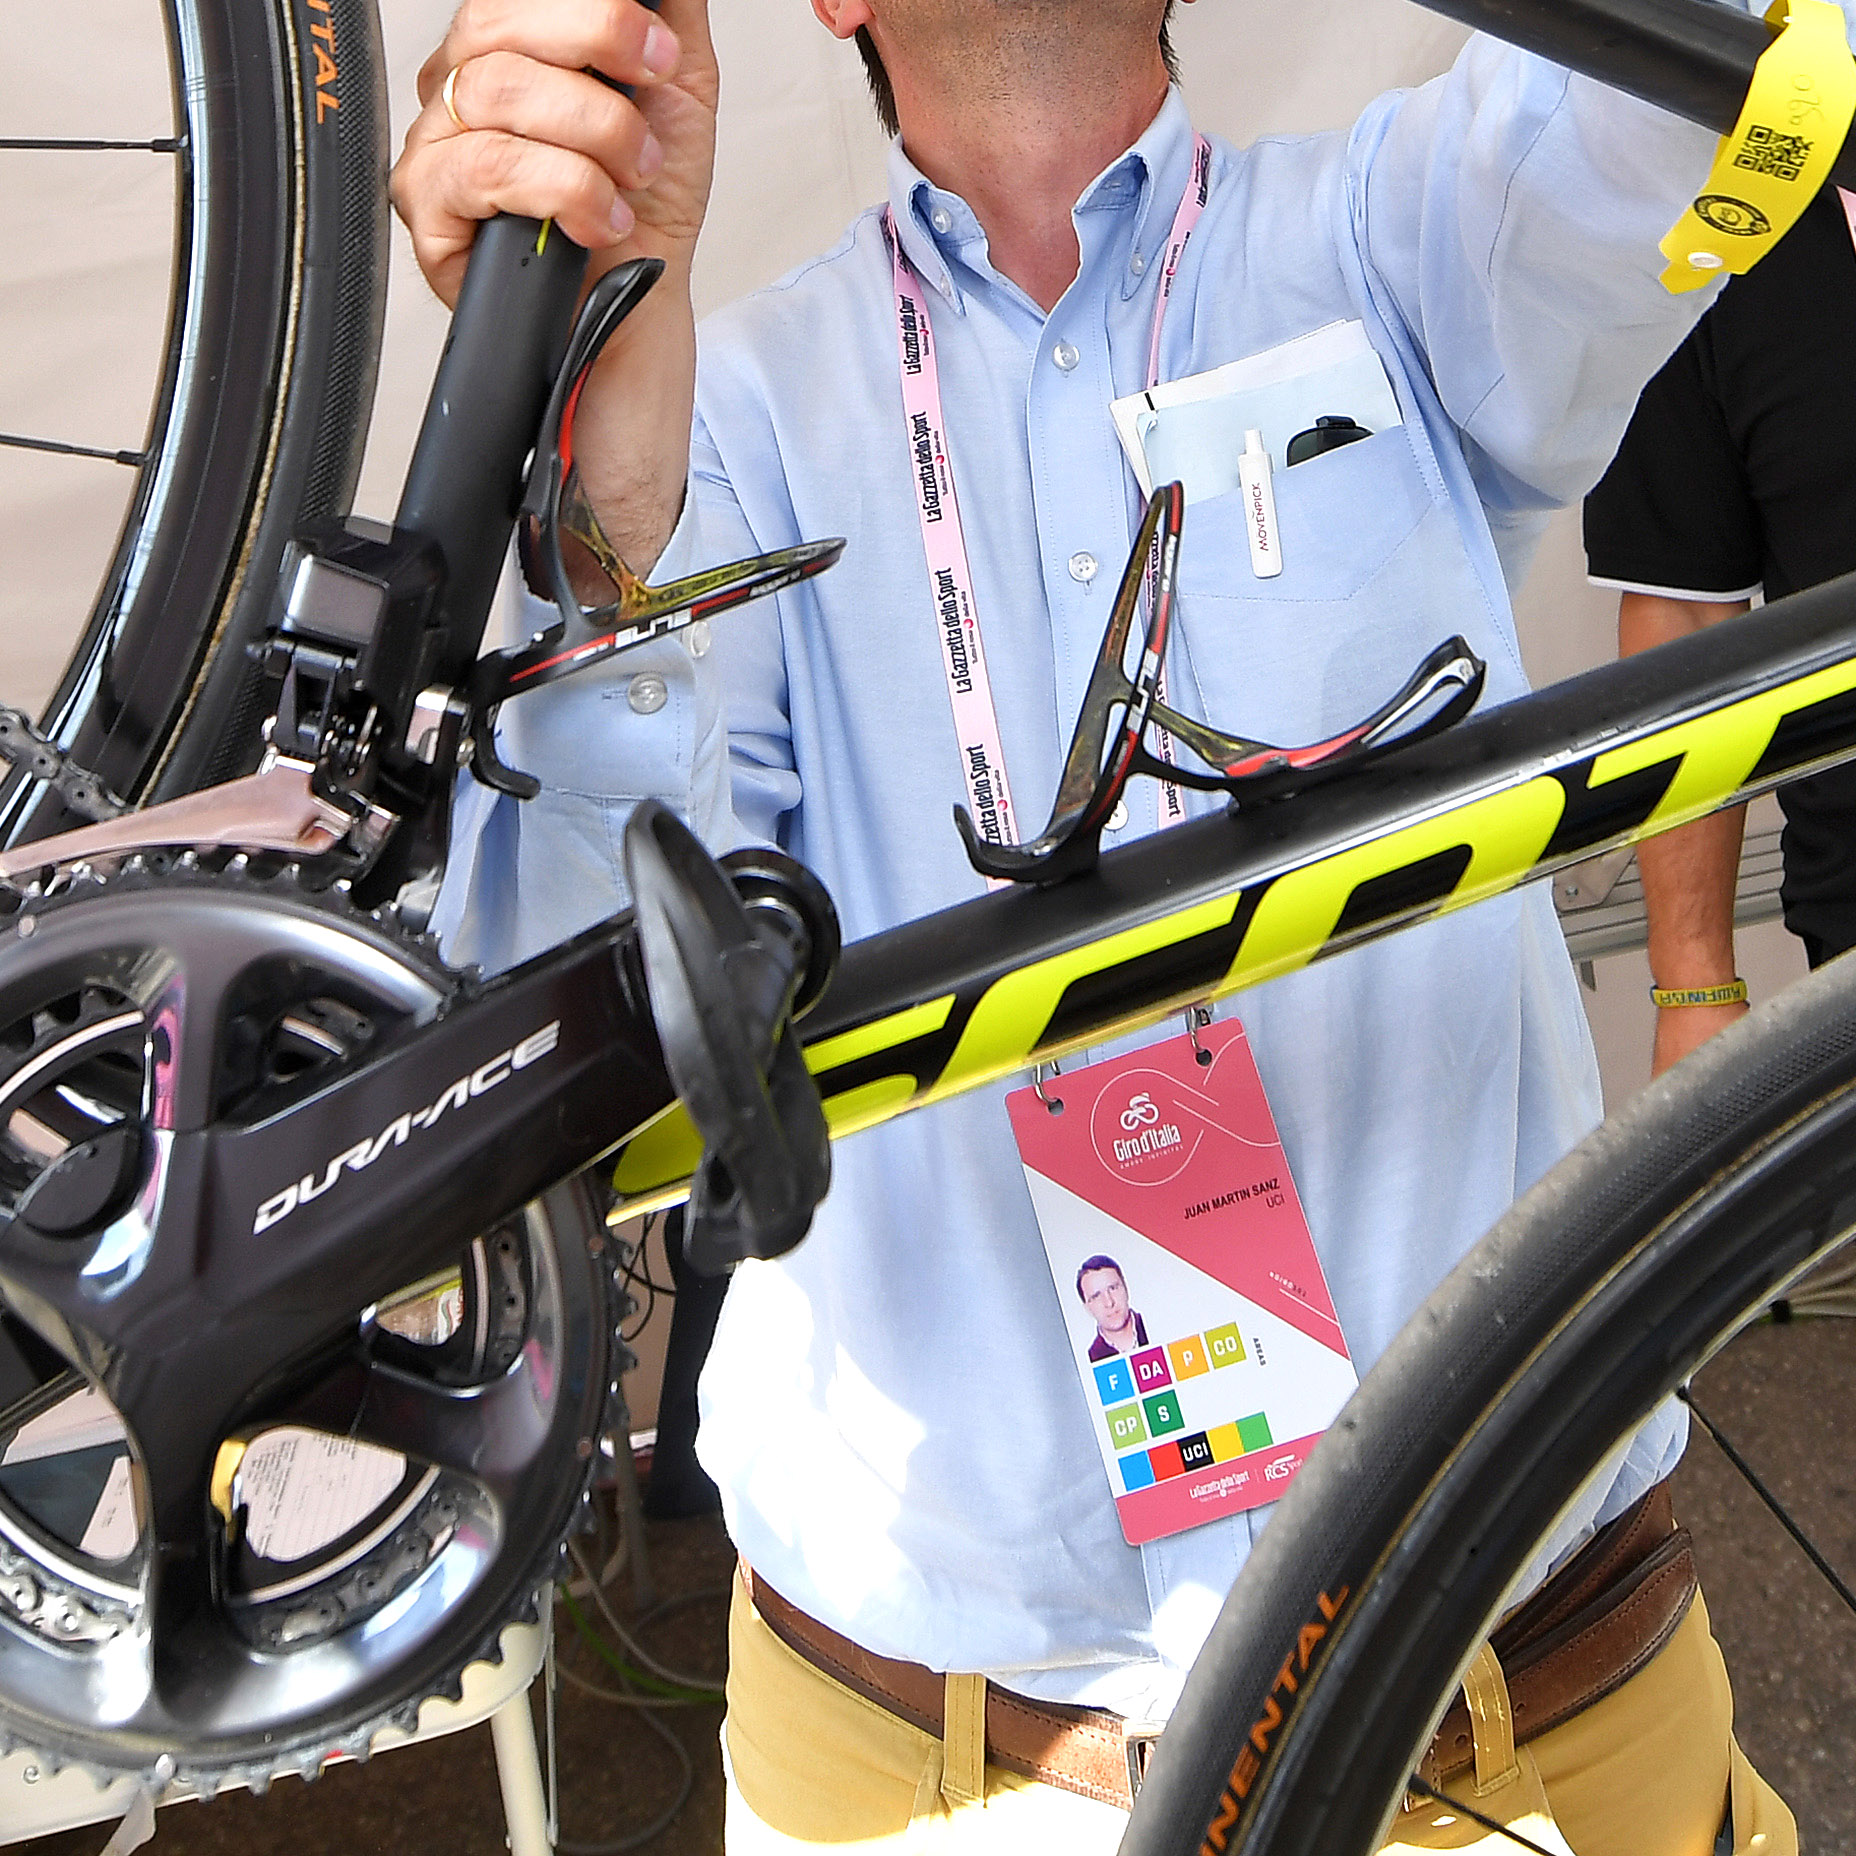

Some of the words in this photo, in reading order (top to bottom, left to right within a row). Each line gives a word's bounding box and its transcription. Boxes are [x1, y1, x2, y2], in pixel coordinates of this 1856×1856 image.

[911, 411, 932, 444] Sport
[915, 441, 932, 466] dello
[920, 464, 940, 515] Gazzetta
[935, 568, 957, 601] Sport
[941, 600, 961, 629] dello
[946, 627, 971, 686] Gazzetta
[966, 744, 989, 778] Sport
[972, 777, 994, 806] dello
[253, 1019, 561, 1235] DURA-ACE
[1113, 1137, 1142, 1162] Giro
[1184, 1201, 1211, 1220] JUAN
[1212, 1186, 1251, 1210] MARTIN
[1251, 1178, 1281, 1197] SANZ
[1266, 1194, 1285, 1209] UCI
[1108, 1374, 1119, 1391] F
[1139, 1360, 1164, 1381] DA
[1182, 1350, 1194, 1367] P
[1214, 1336, 1238, 1356] CO
[1114, 1416, 1138, 1437] CP
[1157, 1405, 1170, 1422] S
[1182, 1442, 1209, 1462] UCI
[1264, 1463, 1289, 1482] RCS
